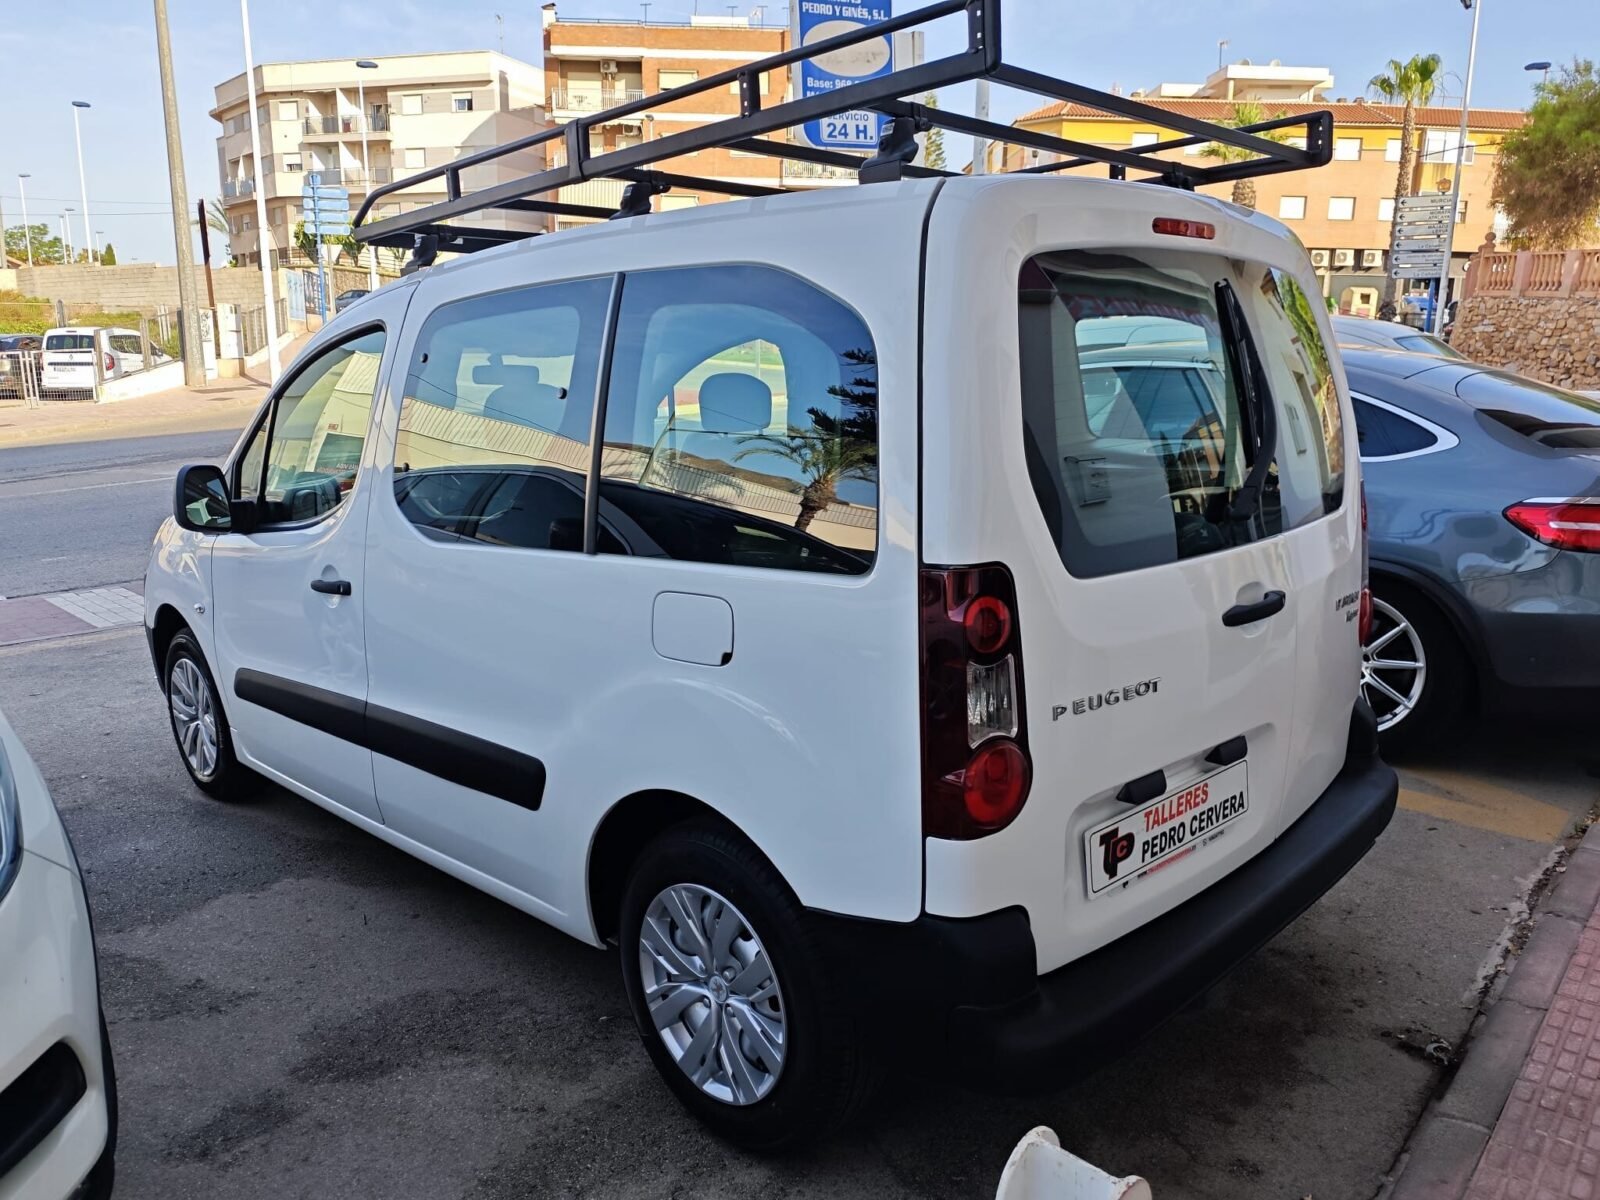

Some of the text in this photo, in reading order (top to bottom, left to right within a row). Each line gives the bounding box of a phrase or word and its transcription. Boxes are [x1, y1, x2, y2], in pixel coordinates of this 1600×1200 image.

[802, 1, 833, 16] PEDRO
[834, 5, 841, 16] Y
[872, 9, 888, 20] S.L.
[807, 77, 833, 88] Base:
[826, 122, 849, 139] 24
[855, 124, 874, 140] H.
[1052, 677, 1161, 721] PEUGEOT
[1144, 782, 1209, 832] TALLERES
[1141, 821, 1186, 863] PEDRO
[1190, 790, 1245, 837] CERVERA
